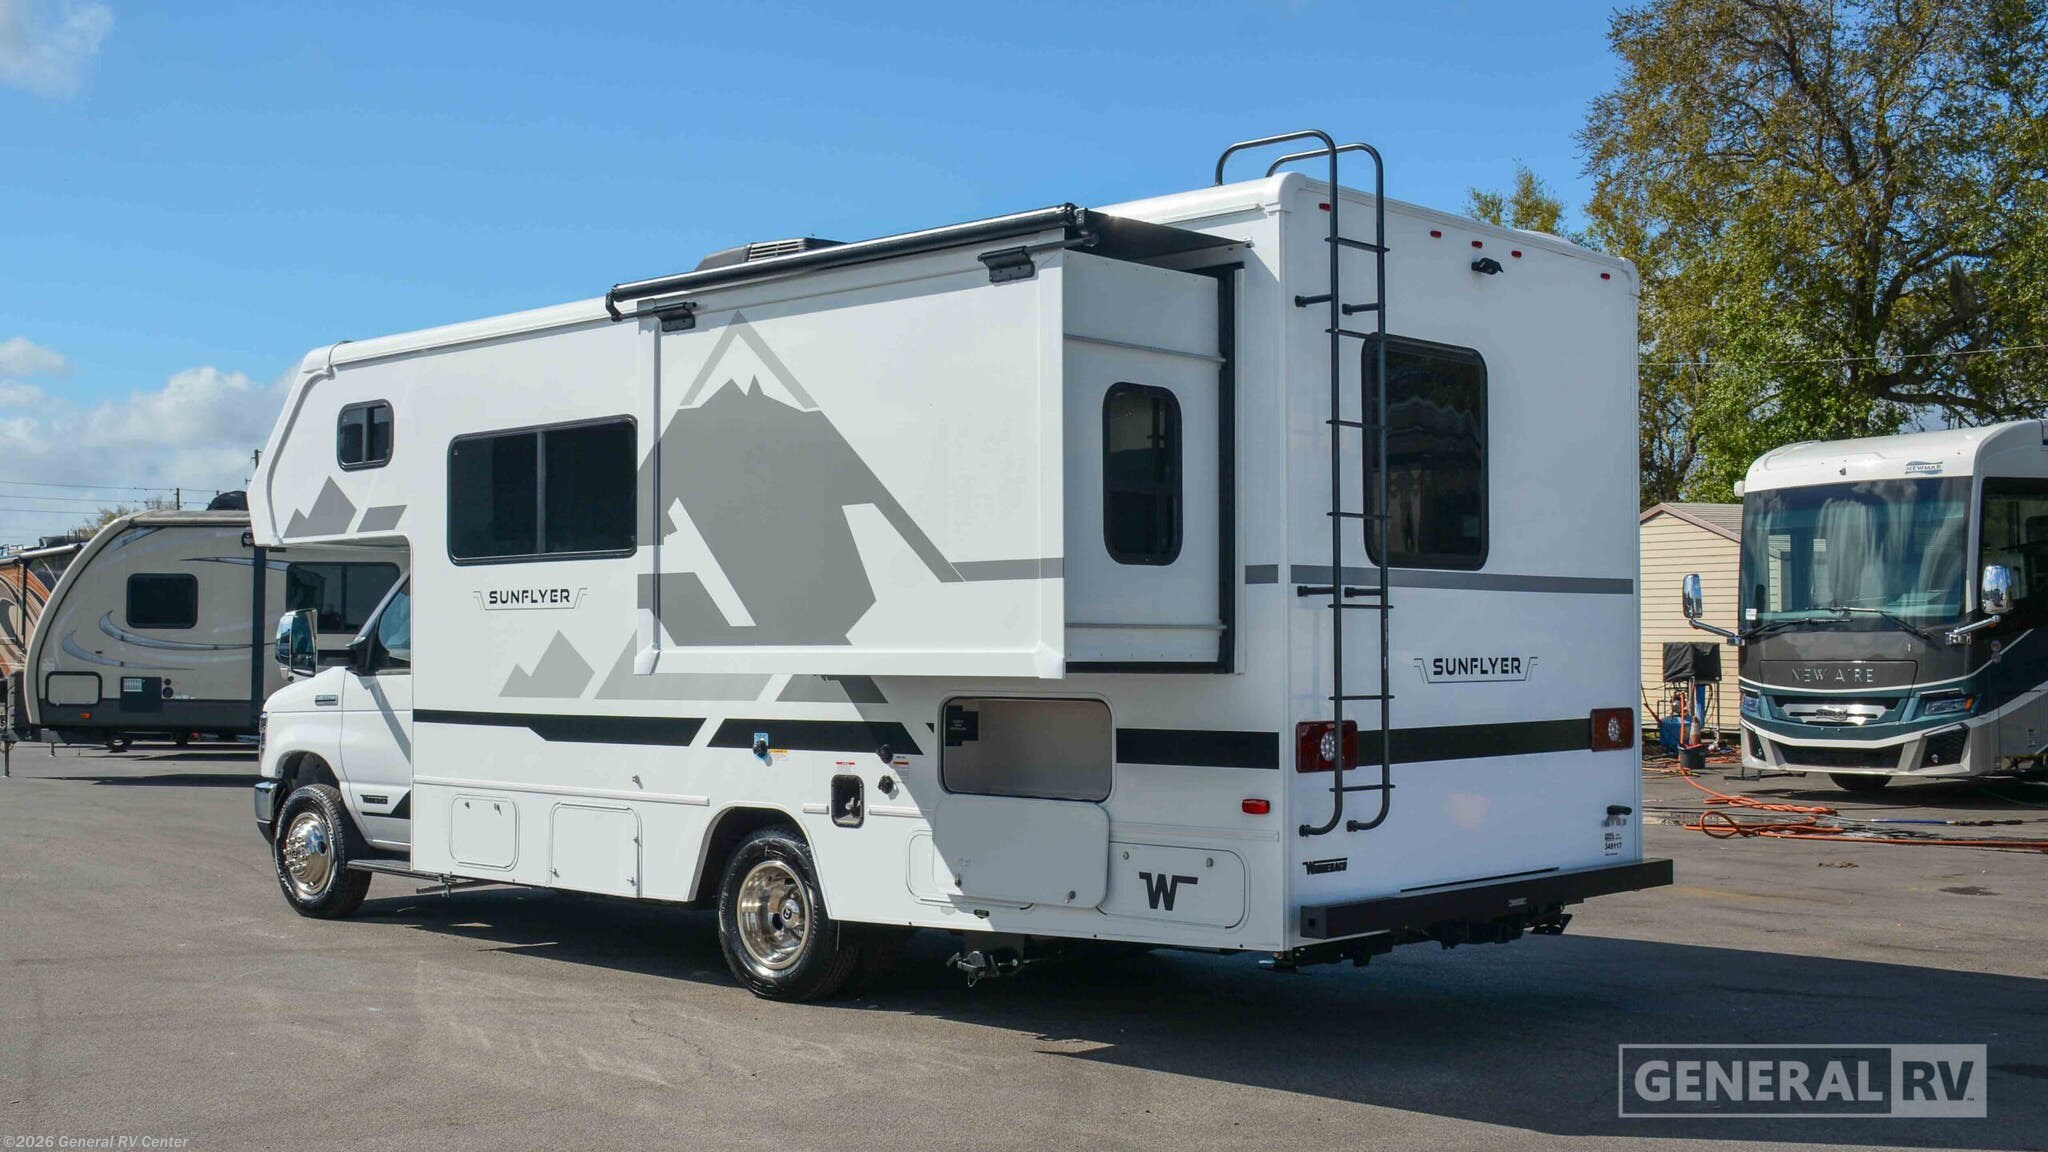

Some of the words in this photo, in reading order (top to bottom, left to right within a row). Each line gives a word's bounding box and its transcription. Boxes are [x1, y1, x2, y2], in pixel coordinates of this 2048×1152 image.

[489, 588, 570, 604] SUNFLYER
[1433, 656, 1521, 675] SUNFLYER
[1835, 668, 1874, 682] ARE
